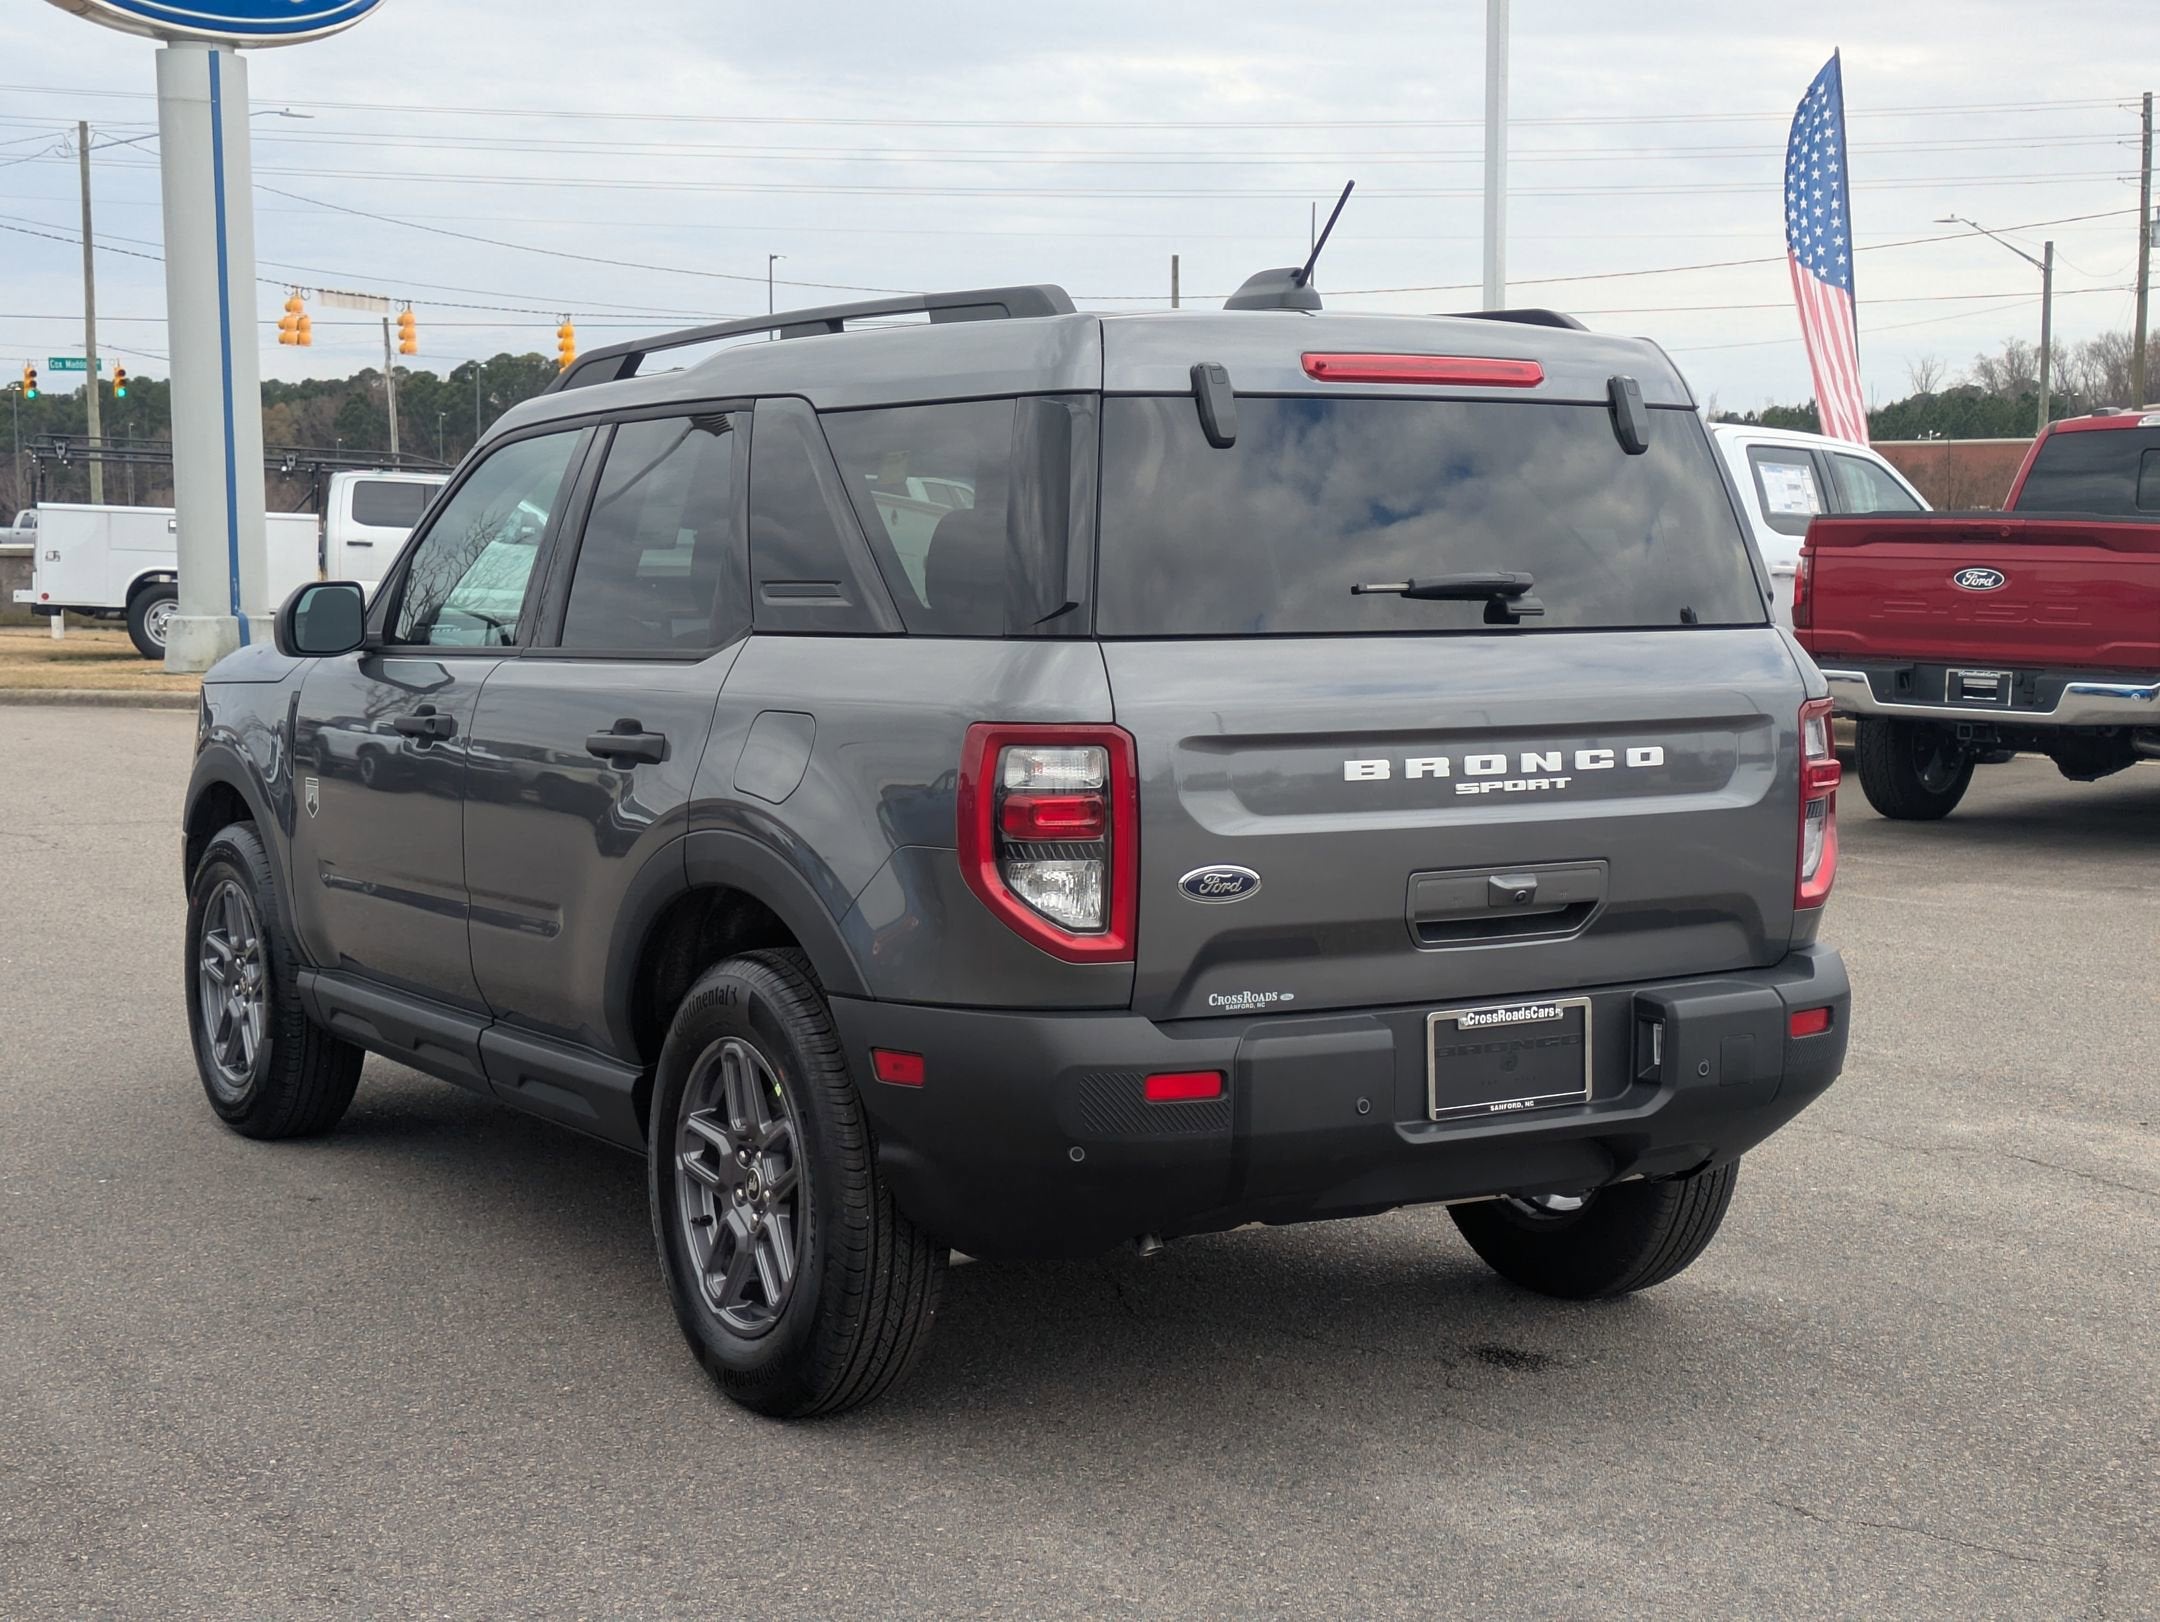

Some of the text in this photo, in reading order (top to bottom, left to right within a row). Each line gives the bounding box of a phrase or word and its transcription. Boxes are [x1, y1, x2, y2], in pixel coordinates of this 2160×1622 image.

[1962, 571, 1995, 587] Ford
[1344, 746, 1664, 781] BRONCO
[1455, 777, 1572, 795] SPORT
[1199, 873, 1243, 894] Ford
[1467, 1006, 1554, 1026] CrossRoadsCars
[1435, 1033, 1581, 1058] BRONCO
[1490, 1102, 1524, 1112] SANFORD,
